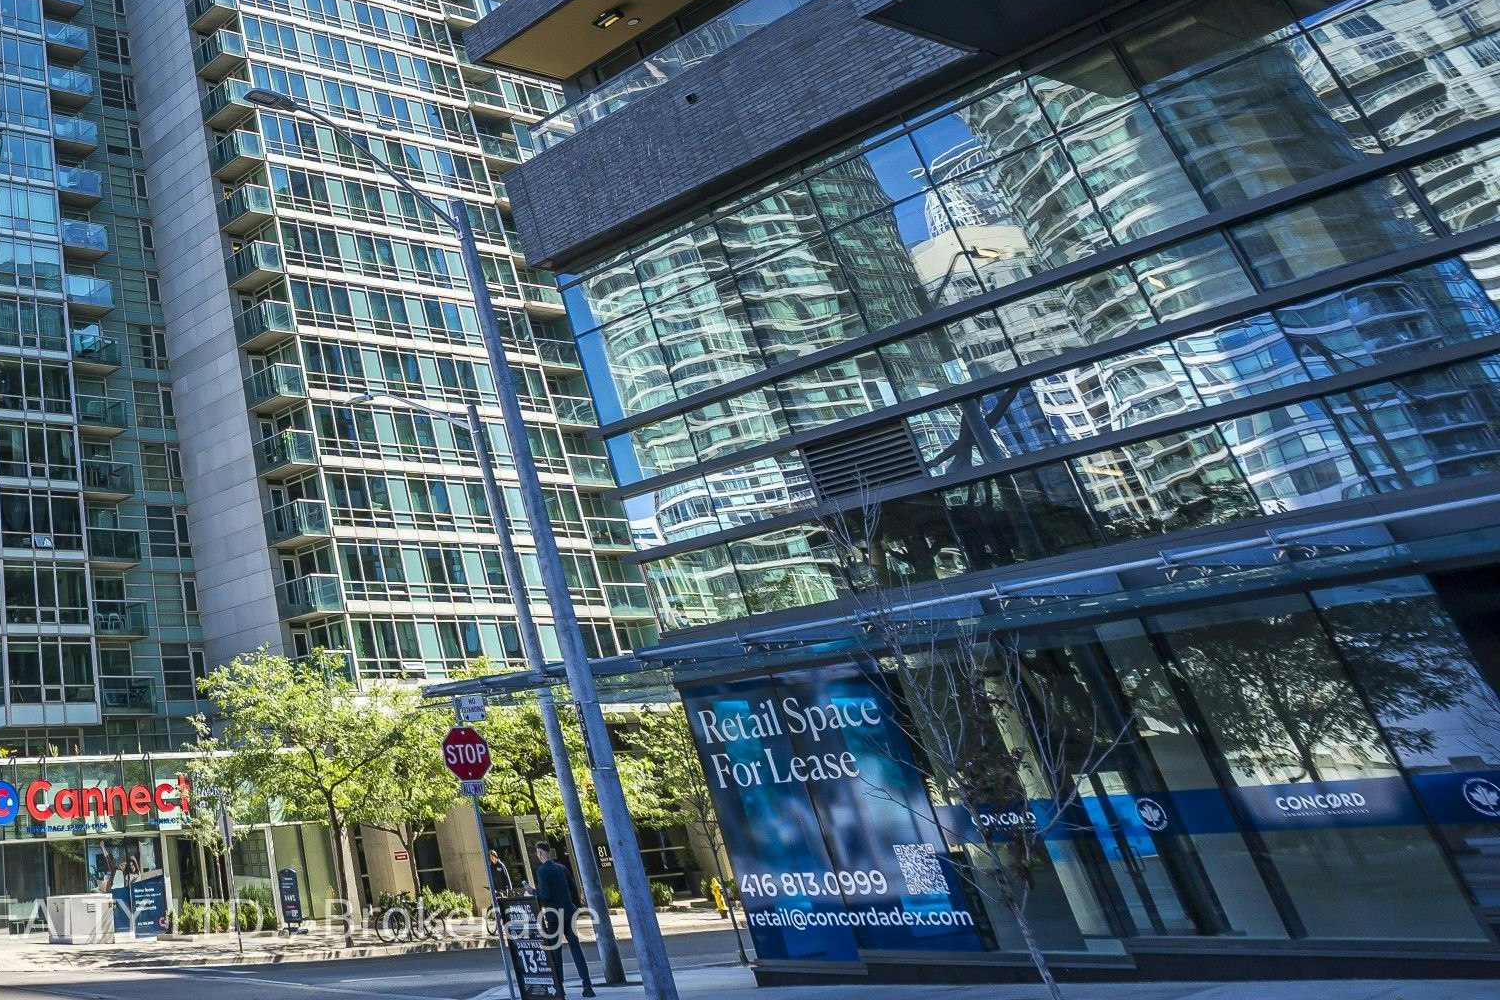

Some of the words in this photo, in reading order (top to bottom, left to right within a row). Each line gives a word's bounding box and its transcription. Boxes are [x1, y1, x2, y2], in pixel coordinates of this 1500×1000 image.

[698, 699, 783, 744] Retail
[782, 697, 881, 742] Space
[446, 743, 485, 764] STOP
[711, 753, 762, 789] For
[764, 748, 860, 784] Lease
[25, 772, 192, 821] Cannect
[597, 845, 607, 857] 81
[740, 872, 778, 897] 416
[780, 870, 888, 897] 813.0999
[509, 904, 531, 913] PUBLIC
[749, 906, 974, 931] retail@concordadex.com
[518, 950, 538, 973] 13
